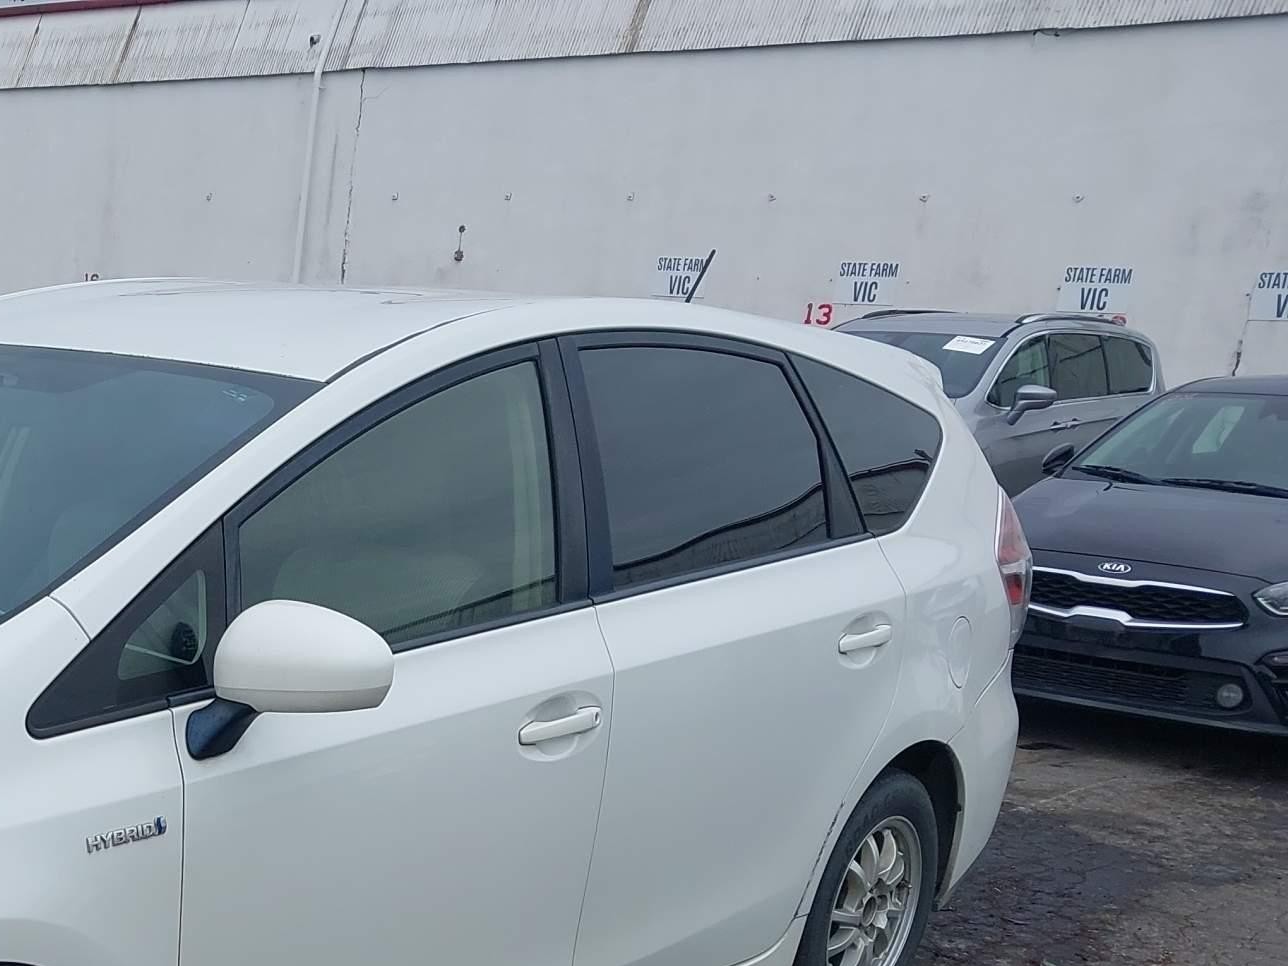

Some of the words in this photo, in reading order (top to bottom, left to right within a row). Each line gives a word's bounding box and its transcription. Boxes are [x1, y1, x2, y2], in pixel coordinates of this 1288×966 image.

[657, 257, 682, 271] STATE
[839, 262, 868, 277] STATE
[870, 263, 899, 278] FARM
[669, 275, 691, 296] VIC
[1065, 267, 1097, 283] STATE
[1098, 268, 1133, 284] FARM
[1258, 272, 1288, 289] STAT
[853, 281, 878, 302] VIC
[1080, 287, 1109, 311] VIC
[804, 302, 833, 325] 13
[86, 822, 154, 854] HYBRID
